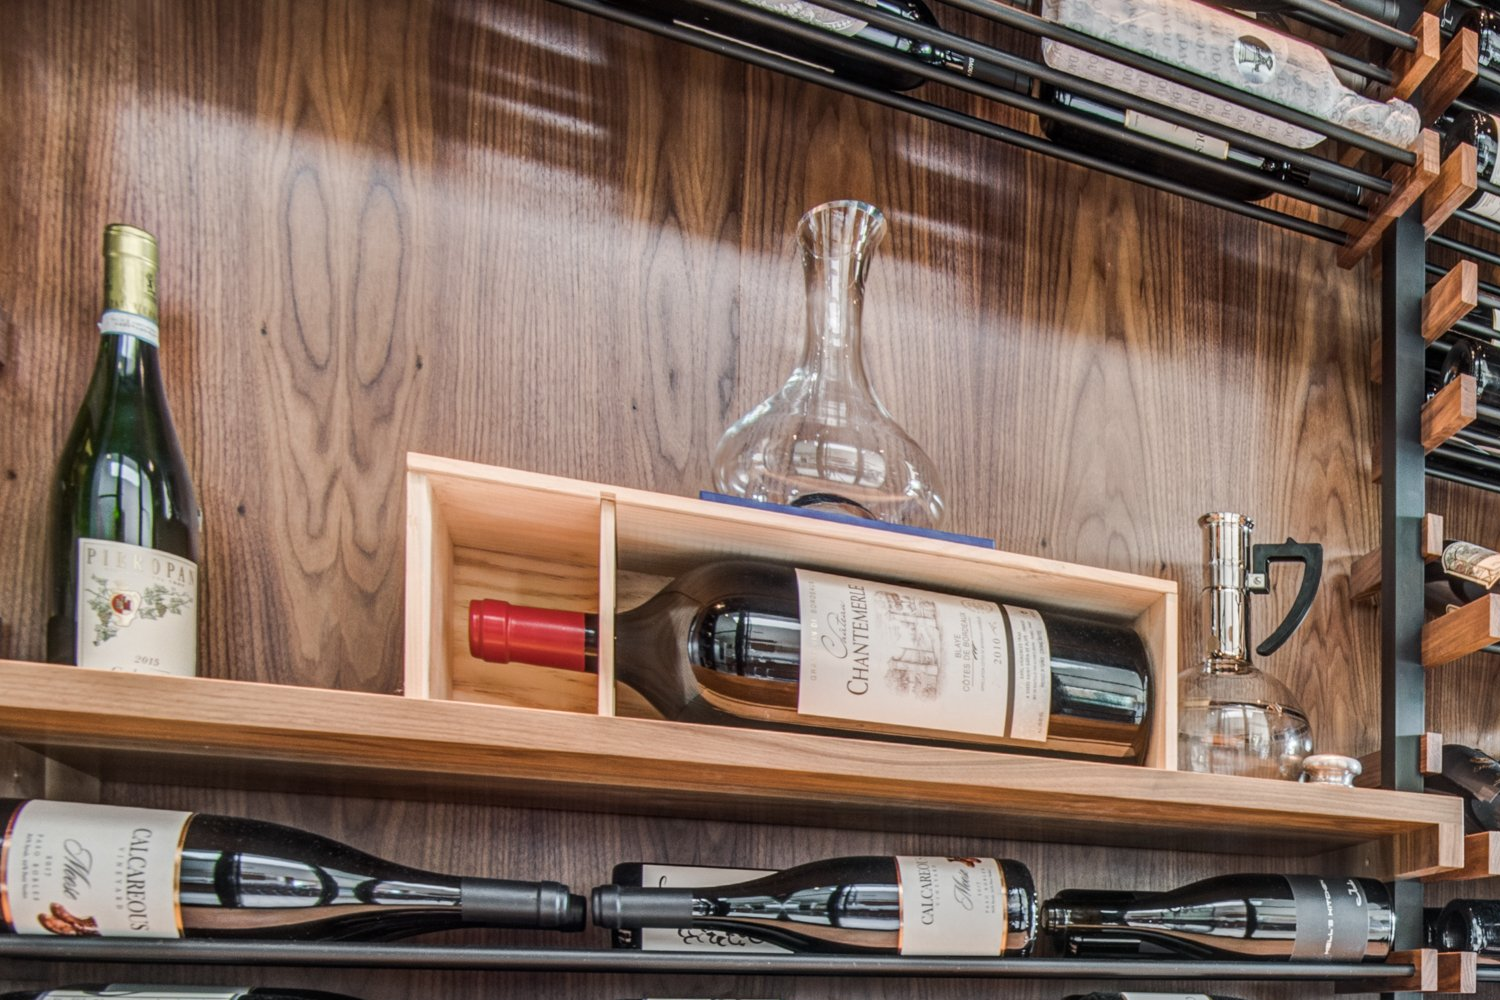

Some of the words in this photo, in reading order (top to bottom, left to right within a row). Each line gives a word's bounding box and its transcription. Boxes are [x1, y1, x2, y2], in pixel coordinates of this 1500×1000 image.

[87, 547, 195, 586] PIEROPAN
[846, 584, 869, 696] CHANTEMERLE
[954, 633, 962, 660] BLAYE
[959, 612, 971, 648] BORDEAUX
[133, 655, 161, 667] 2015
[962, 648, 971, 662] DE
[992, 637, 1002, 666] 2010
[960, 663, 971, 692] CÔTES
[63, 838, 93, 901] Moose
[114, 846, 125, 911] VINEYARD
[126, 828, 153, 931] CALCAREOUS
[1324, 919, 1334, 955] HELL'S
